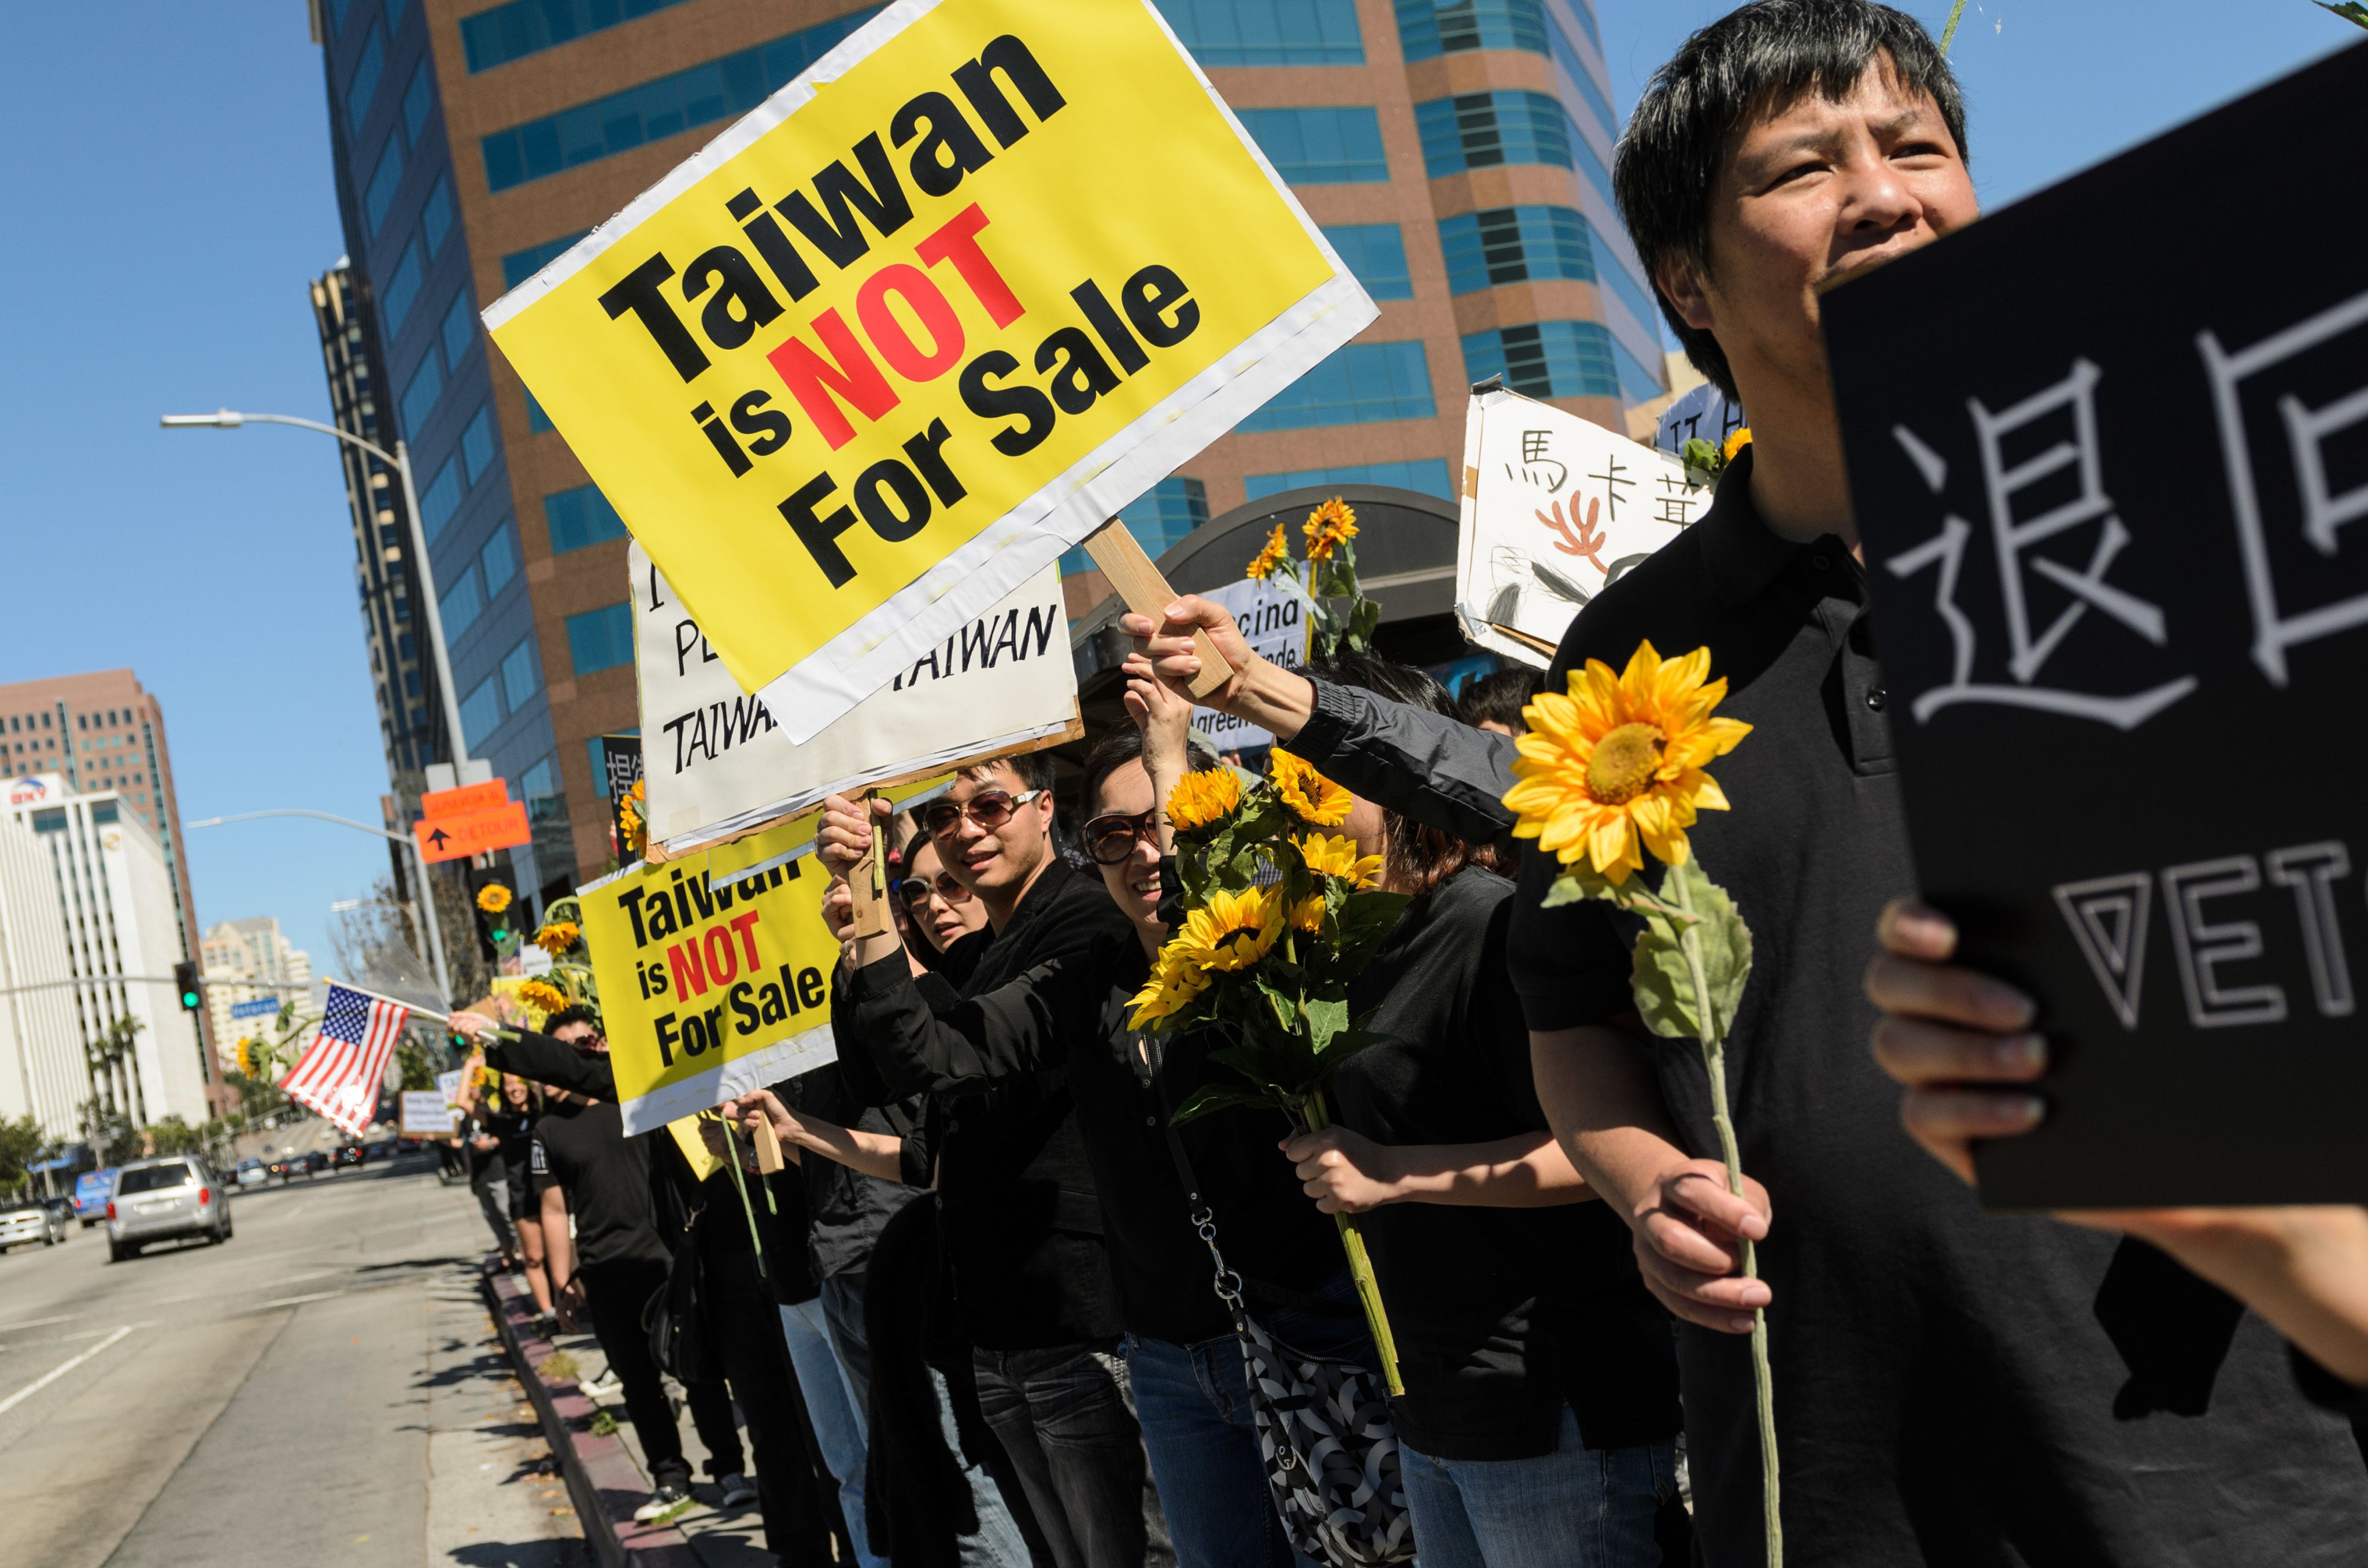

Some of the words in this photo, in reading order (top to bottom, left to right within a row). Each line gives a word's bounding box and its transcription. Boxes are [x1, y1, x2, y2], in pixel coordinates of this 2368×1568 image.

[598, 34, 1066, 384] Taiwan
[692, 389, 792, 479] is
[766, 202, 1026, 451] NOT
[778, 417, 968, 590] For
[959, 264, 1200, 457] Sale
[1722, 402, 1748, 448] H
[607, 751, 643, 805] 捍
[663, 693, 778, 774] TAIWA
[457, 817, 519, 842] DETOUR
[637, 961, 668, 1000] is
[667, 910, 761, 1003] NOT
[2052, 840, 2368, 1032] VET
[654, 1005, 722, 1067] For
[730, 963, 826, 1036] Sale
